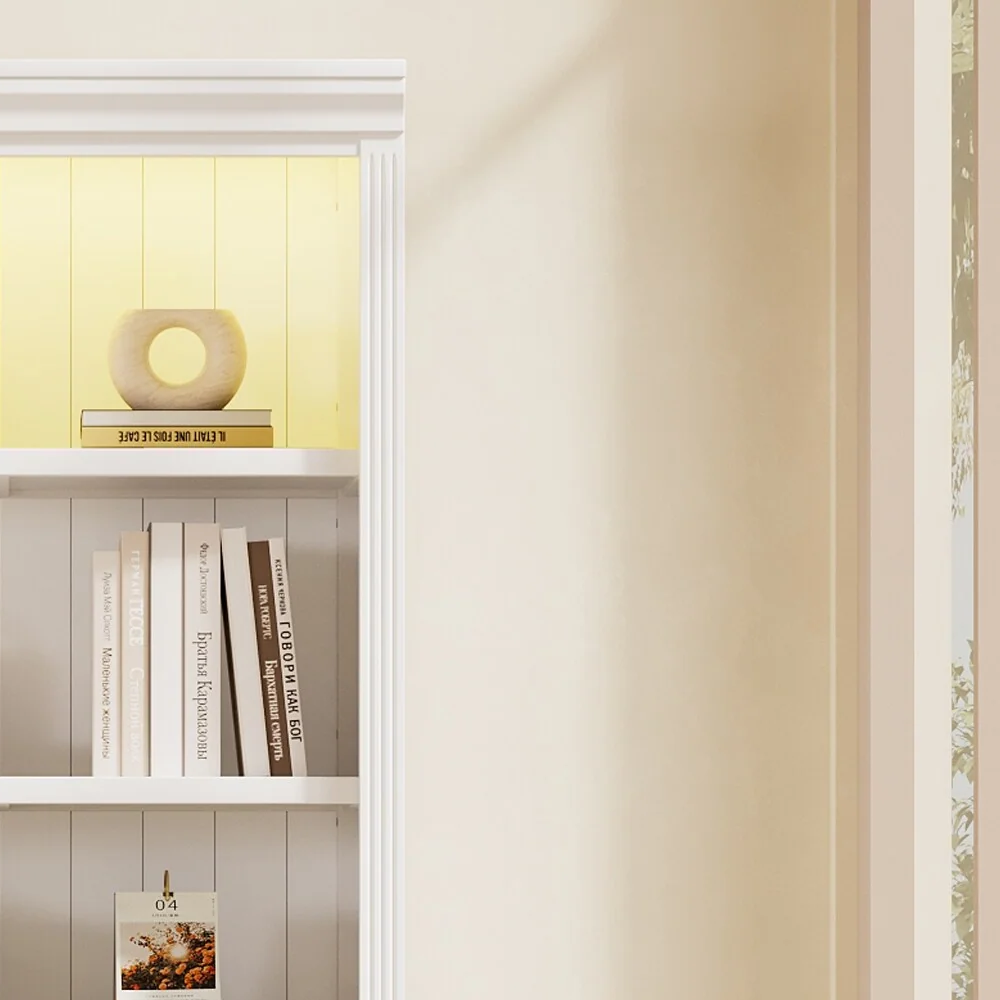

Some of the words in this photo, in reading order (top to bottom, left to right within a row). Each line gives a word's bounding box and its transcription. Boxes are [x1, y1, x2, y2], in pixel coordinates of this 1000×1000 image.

[142, 431, 151, 441] LE
[154, 431, 172, 442] FOIS
[175, 431, 190, 441] UNE
[218, 431, 226, 441] IL
[275, 559, 284, 587] КСЕНИЯ
[257, 584, 270, 605] НОРА
[129, 598, 144, 646] ГЕССЕ
[190, 632, 212, 676] Братья
[279, 622, 297, 683] ГОВОРИ
[102, 648, 113, 705] Маленькие
[263, 660, 281, 720] Бархатная
[286, 689, 299, 713] КАК
[100, 709, 112, 759] женщины
[192, 681, 212, 760] Карамазовы
[289, 719, 302, 743] БОГ
[269, 722, 284, 761] смерть
[155, 899, 178, 911] 04
